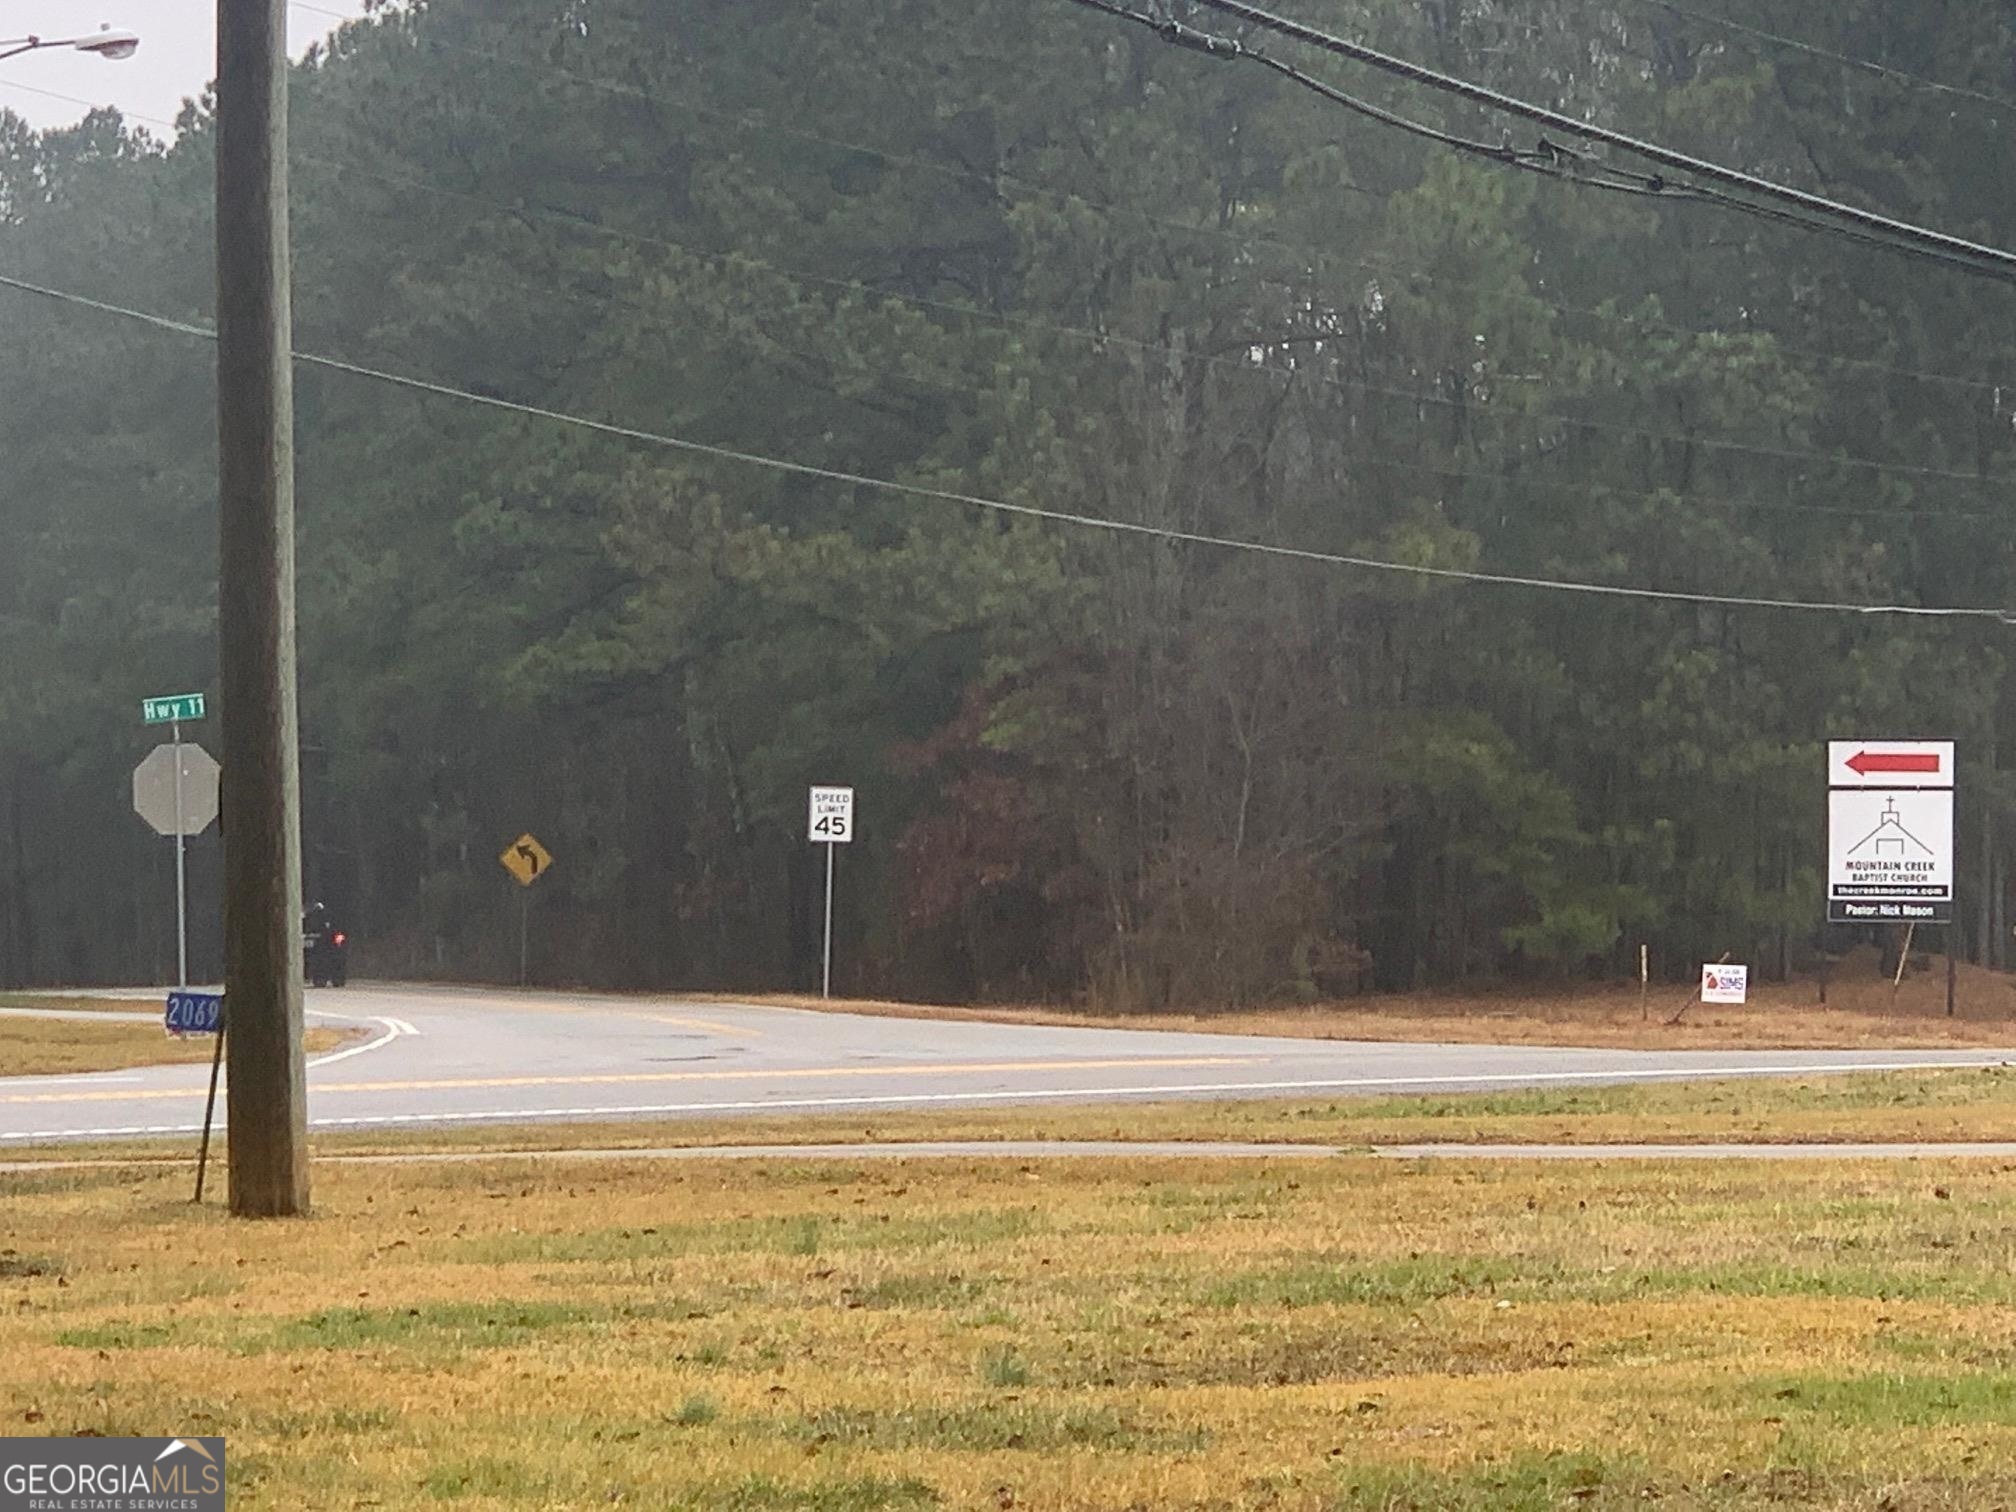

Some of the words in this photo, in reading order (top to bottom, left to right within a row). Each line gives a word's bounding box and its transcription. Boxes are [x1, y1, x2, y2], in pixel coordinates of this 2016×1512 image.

[144, 702, 180, 720] Hwy
[188, 698, 204, 715] 11
[814, 793, 850, 803] SPEED
[817, 805, 845, 814] LIMIT
[814, 816, 846, 836] 45
[1845, 861, 1901, 871] MOUNTAIN
[1904, 861, 1935, 871] CREEK
[1852, 873, 1888, 882] BAPTIST
[1890, 873, 1928, 882] CHURCH
[168, 998, 219, 1026] 2069
